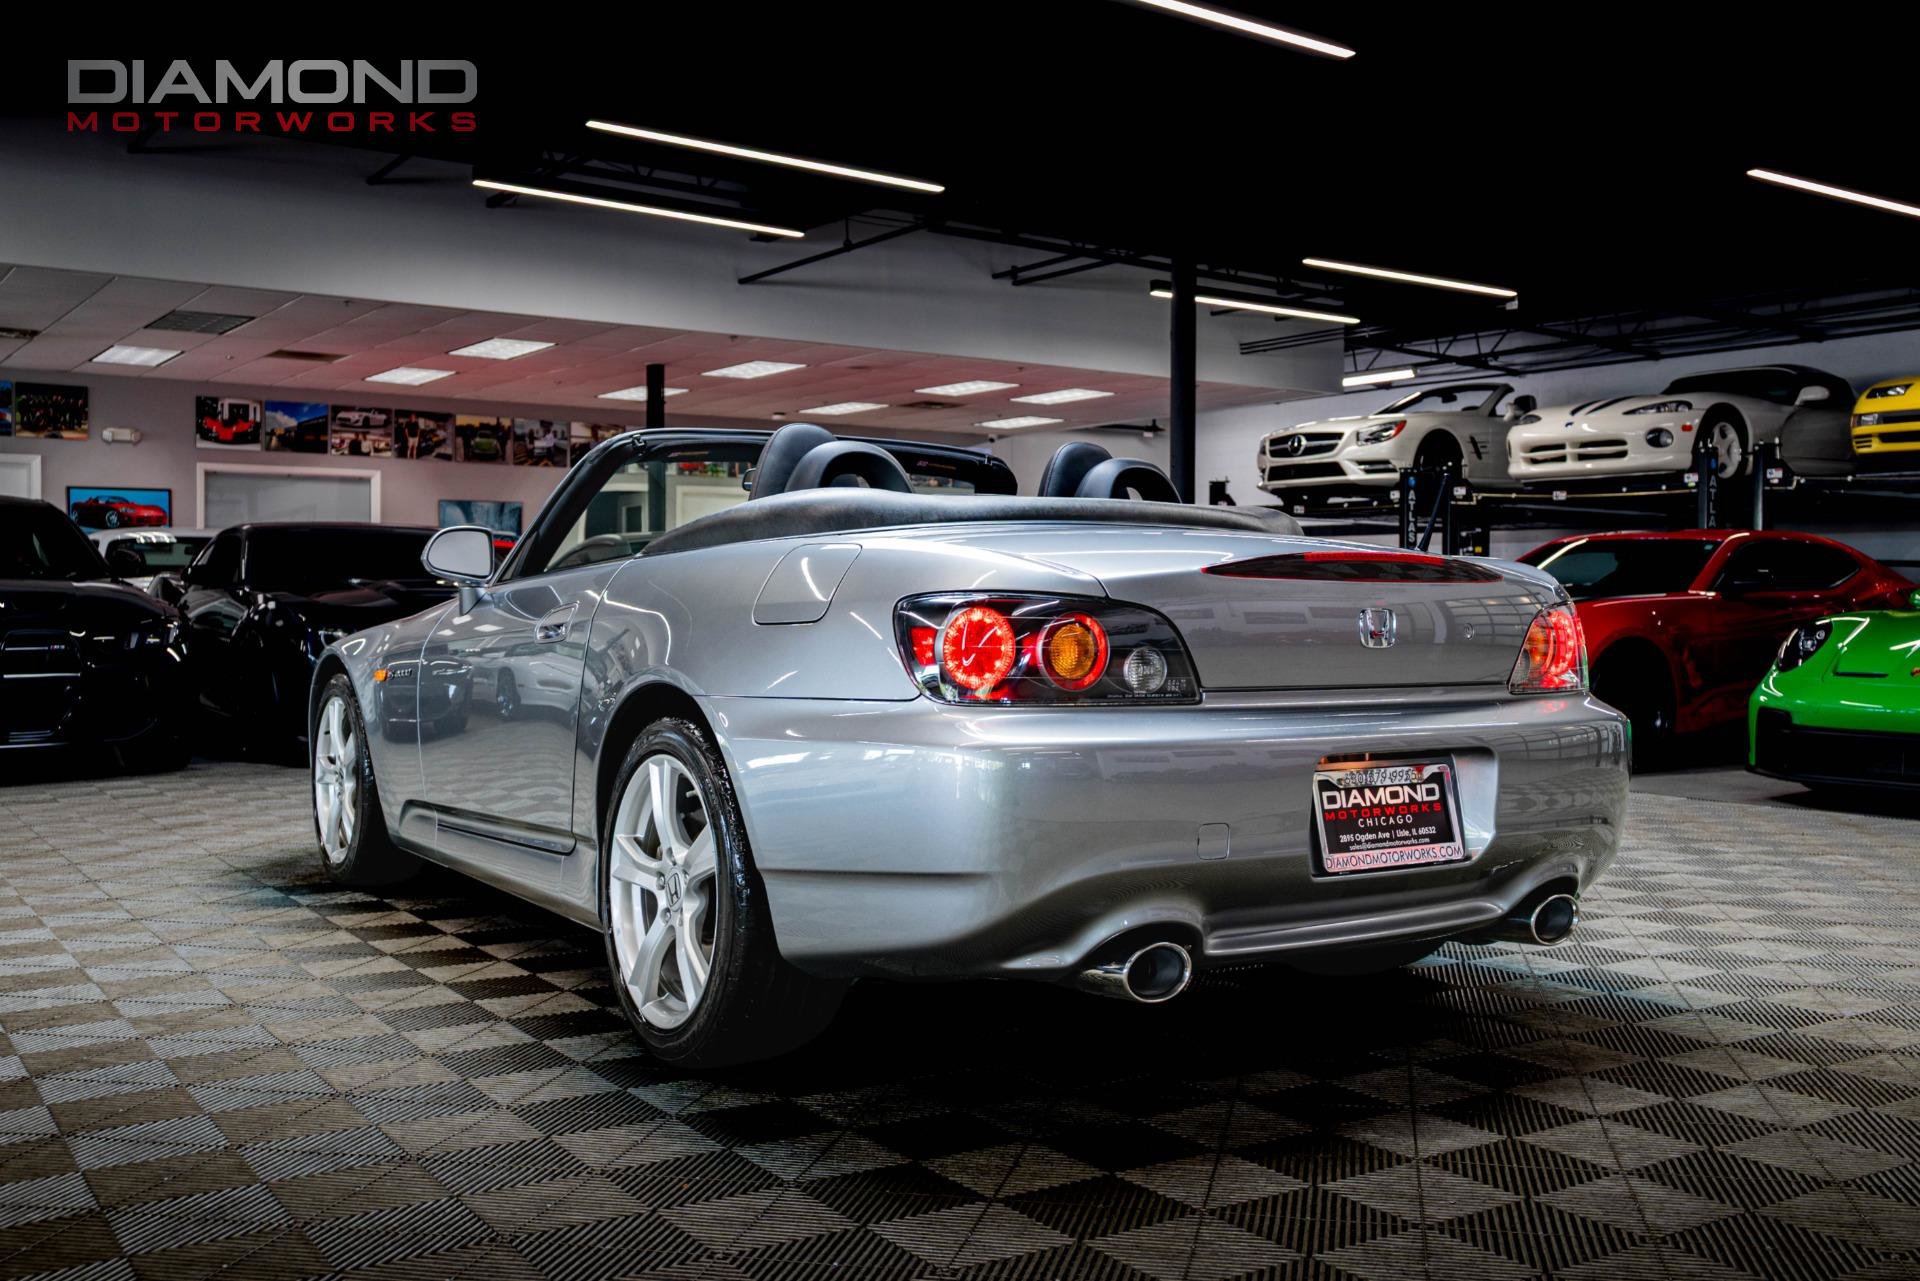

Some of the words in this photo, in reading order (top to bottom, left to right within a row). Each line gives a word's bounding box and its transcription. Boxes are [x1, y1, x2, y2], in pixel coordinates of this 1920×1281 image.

[1707, 473, 1718, 528] ATLA
[1407, 489, 1417, 543] ATLAS
[1322, 783, 1440, 810] DIAMOND
[1324, 802, 1442, 822] MOTORWORKS
[1358, 814, 1413, 828] CHICAGO
[1339, 833, 1355, 843] 2895
[1355, 832, 1377, 842] Ogden
[1377, 831, 1390, 839] Ave
[1418, 826, 1436, 834] 60532
[1325, 845, 1462, 869] DIAMONDMOTORWORKS.COM
